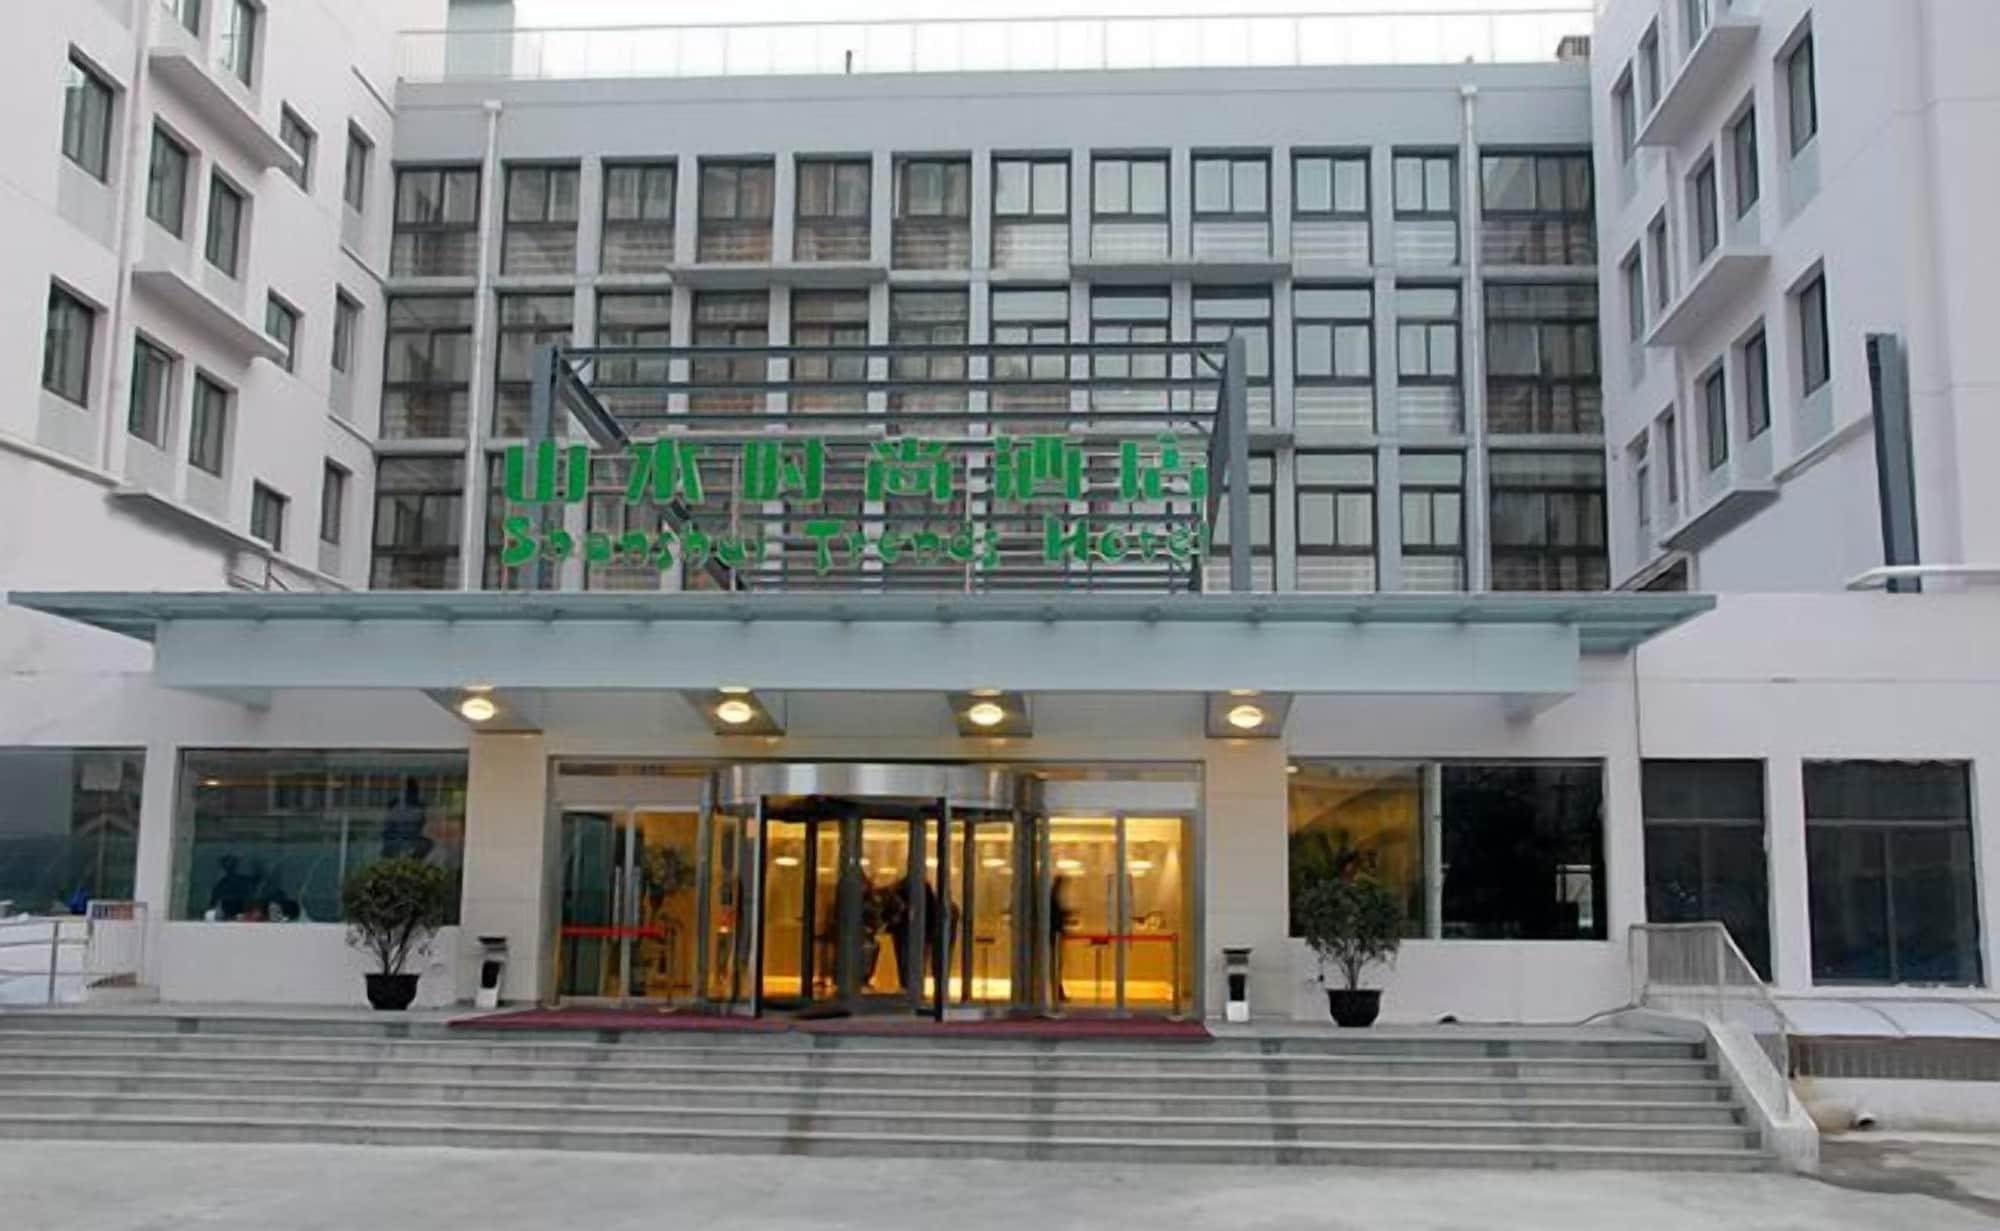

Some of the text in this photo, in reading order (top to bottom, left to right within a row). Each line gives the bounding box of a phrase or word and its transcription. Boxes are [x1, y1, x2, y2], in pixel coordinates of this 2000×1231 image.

[502, 433, 1208, 503] 山水时尚酒店
[803, 519, 1000, 574] Trends
[1043, 513, 1208, 562] Hotel
